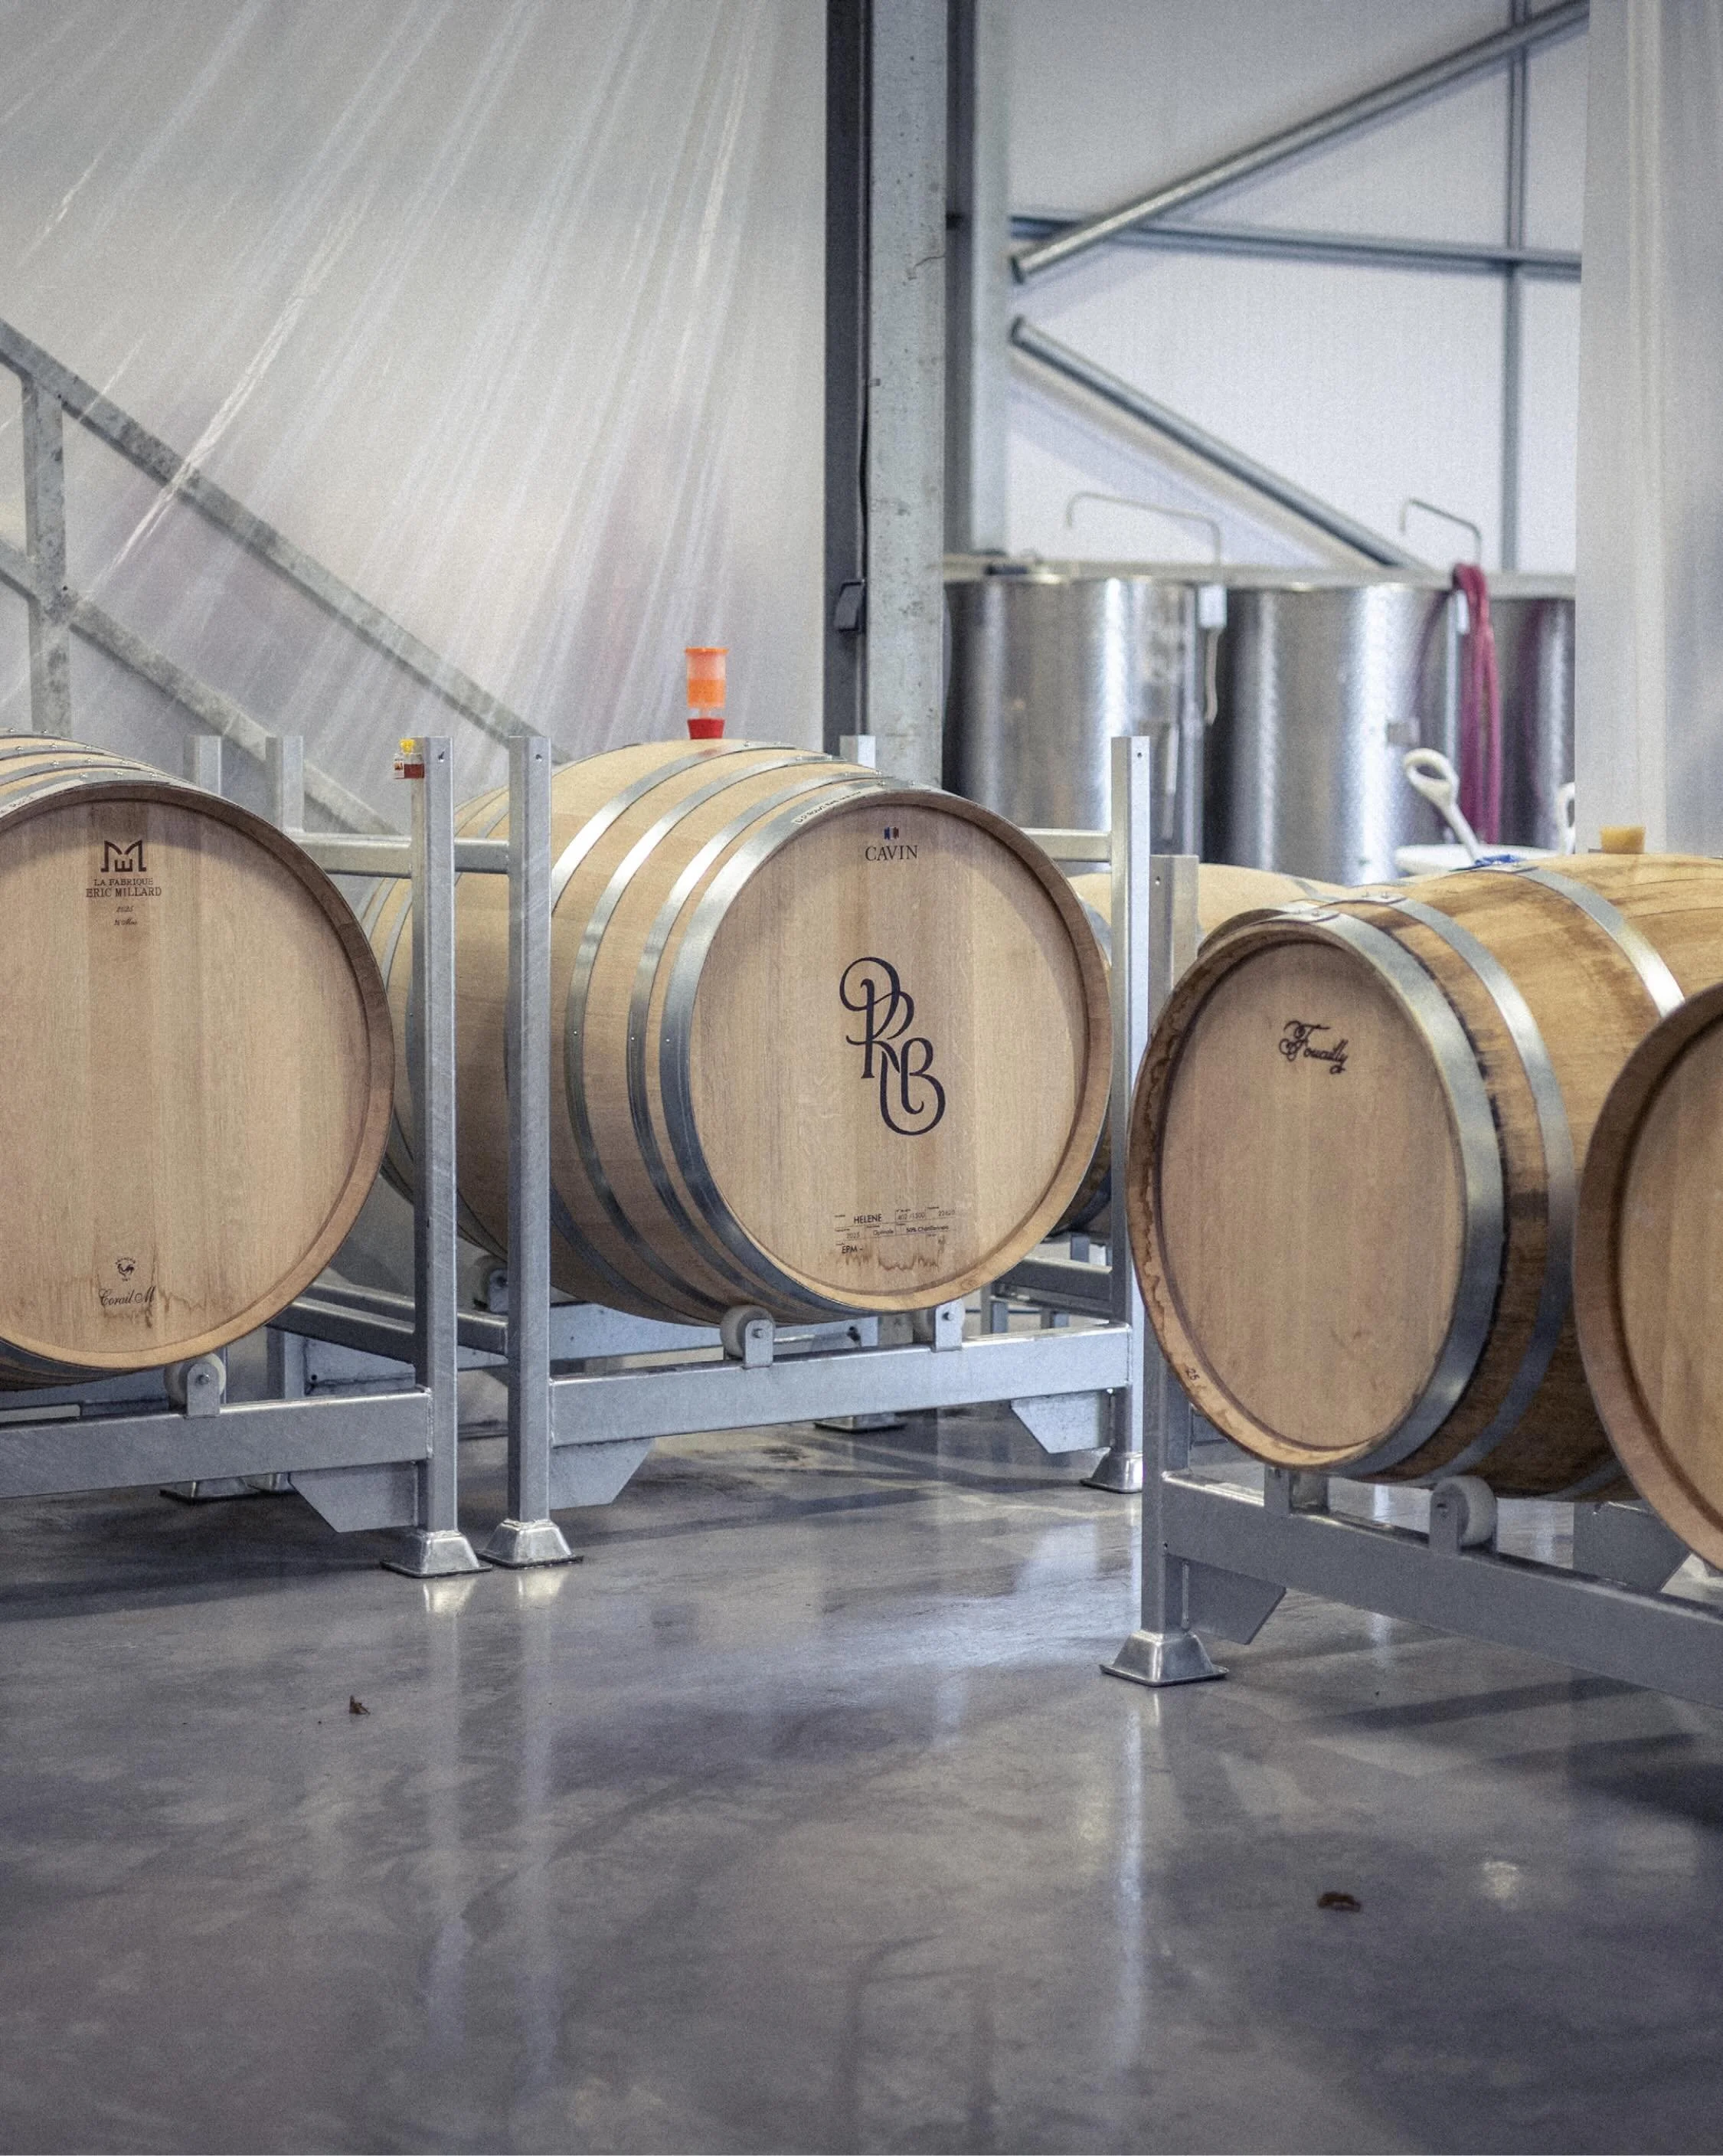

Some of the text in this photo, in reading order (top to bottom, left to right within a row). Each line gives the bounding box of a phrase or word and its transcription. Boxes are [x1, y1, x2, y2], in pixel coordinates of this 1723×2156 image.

[865, 845, 918, 862] CAVIN
[86, 887, 162, 898] ERIC MILLARD
[853, 1213, 881, 1225] HELENE
[842, 1245, 858, 1254] EPM
